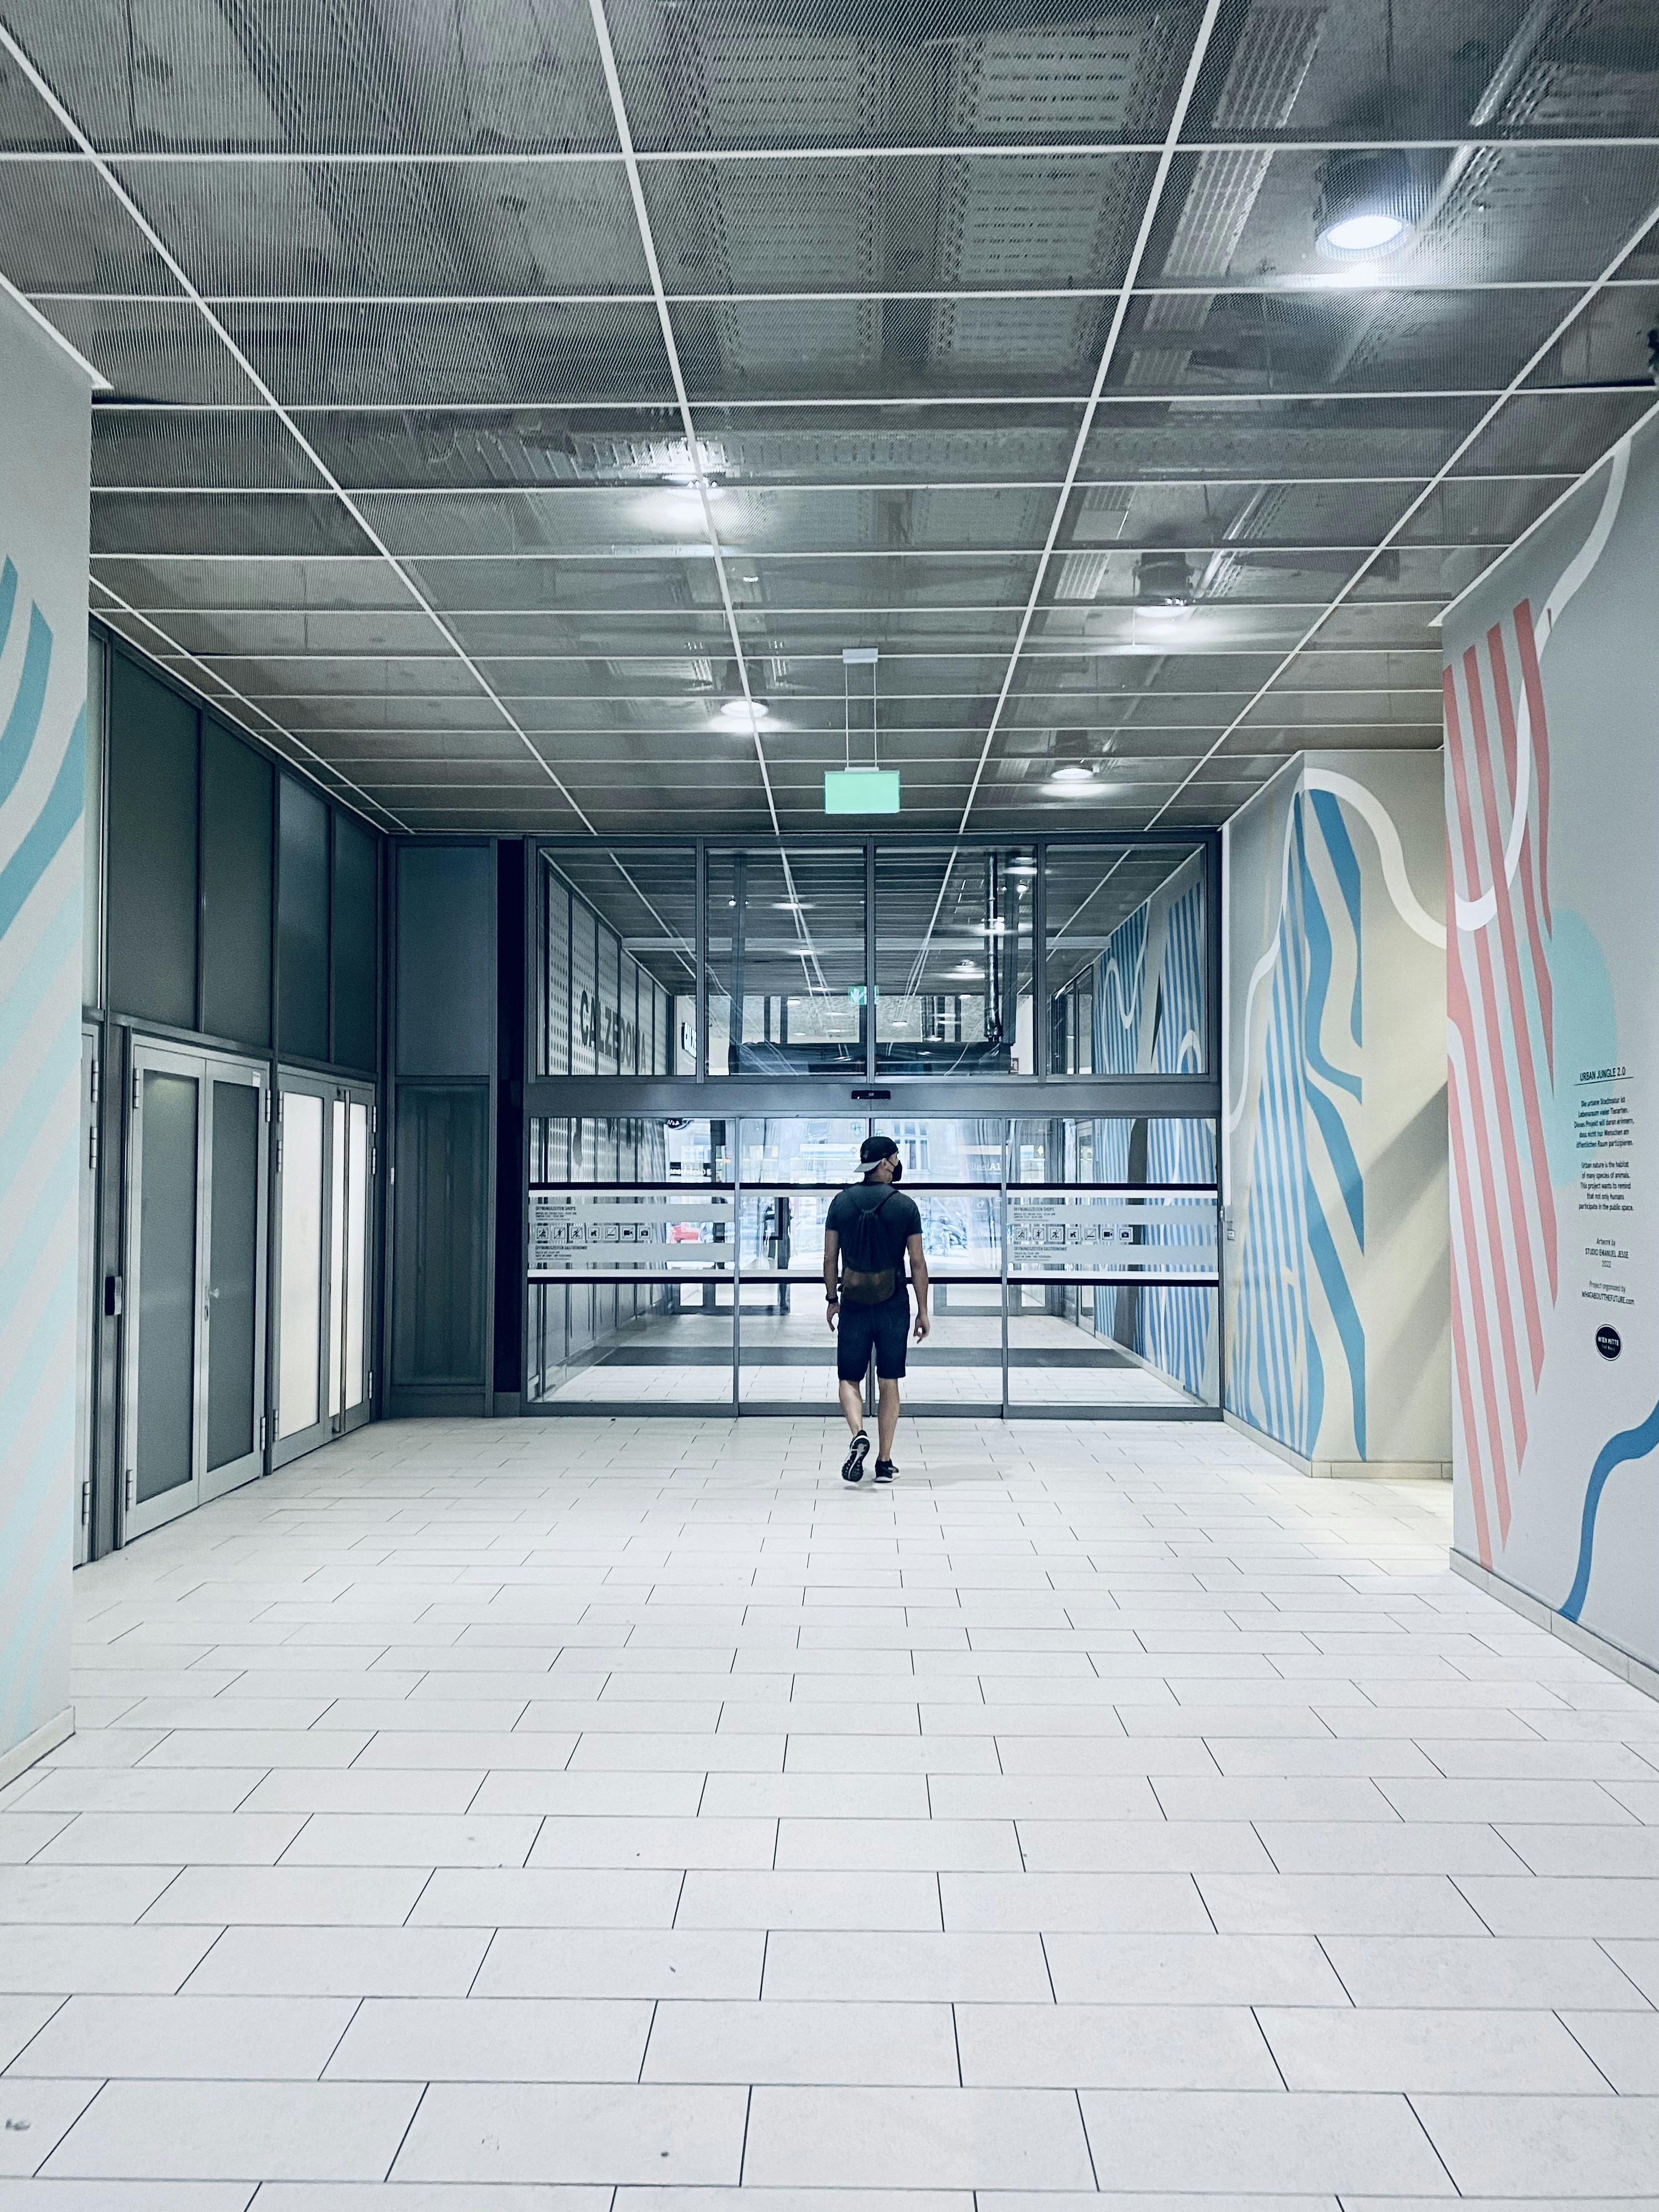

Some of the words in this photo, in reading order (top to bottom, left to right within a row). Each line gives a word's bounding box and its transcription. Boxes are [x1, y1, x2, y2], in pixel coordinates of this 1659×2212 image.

[1580, 1070, 1596, 1081] URBAN
[1596, 1068, 1616, 1079] JUNGLE
[1617, 1066, 1626, 1076] 2.0
[1589, 1280, 1602, 1289] Project
[1622, 1285, 1626, 1294] by
